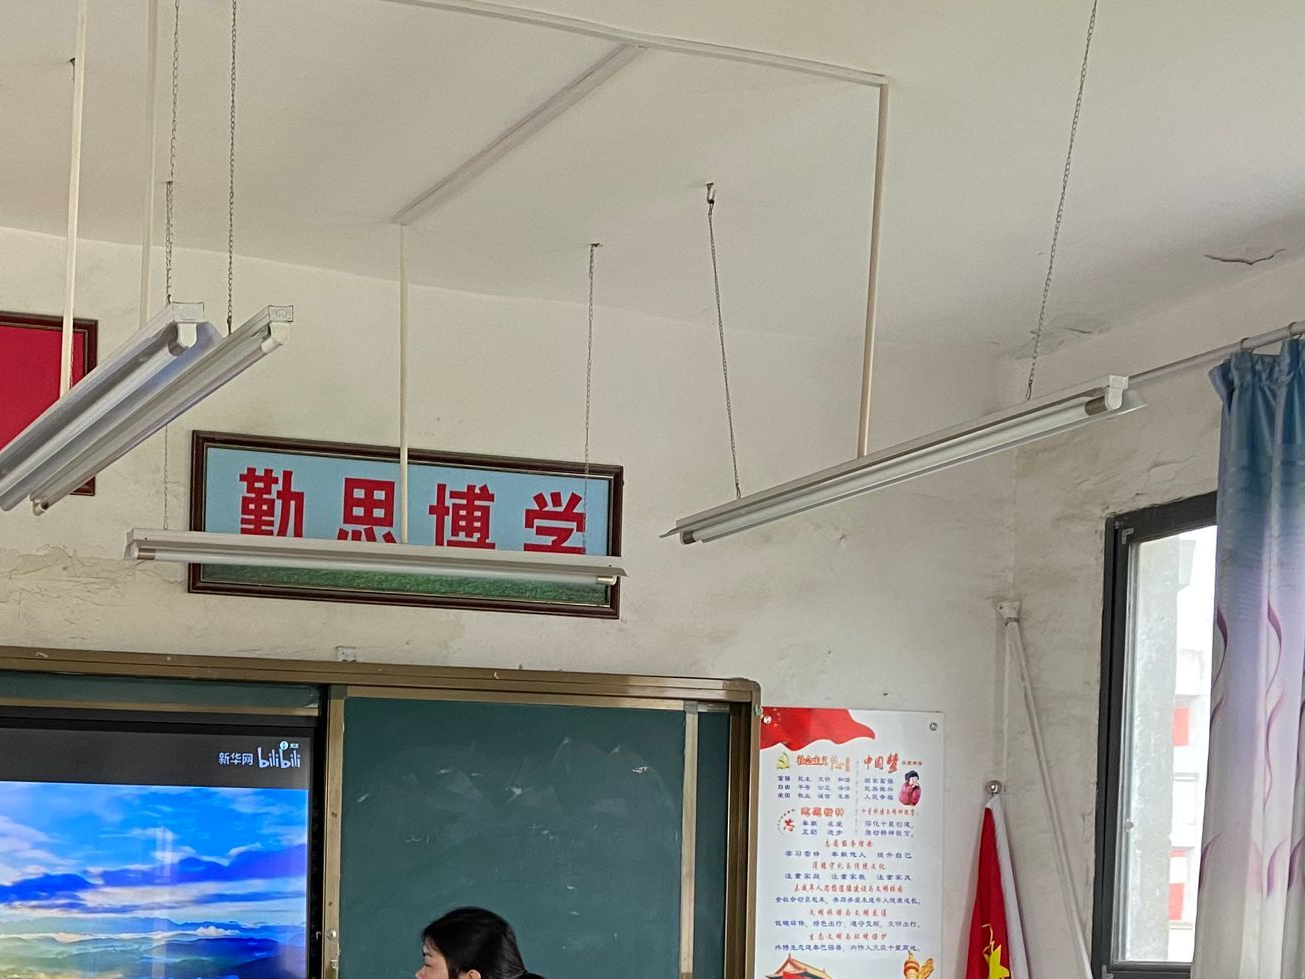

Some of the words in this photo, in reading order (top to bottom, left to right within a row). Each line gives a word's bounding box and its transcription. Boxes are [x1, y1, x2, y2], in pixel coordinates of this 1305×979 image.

[239, 466, 586, 555] 勤思博学
[218, 751, 254, 766] 新华网
[257, 746, 301, 769] bilibili
[863, 752, 899, 774] 中国梦
